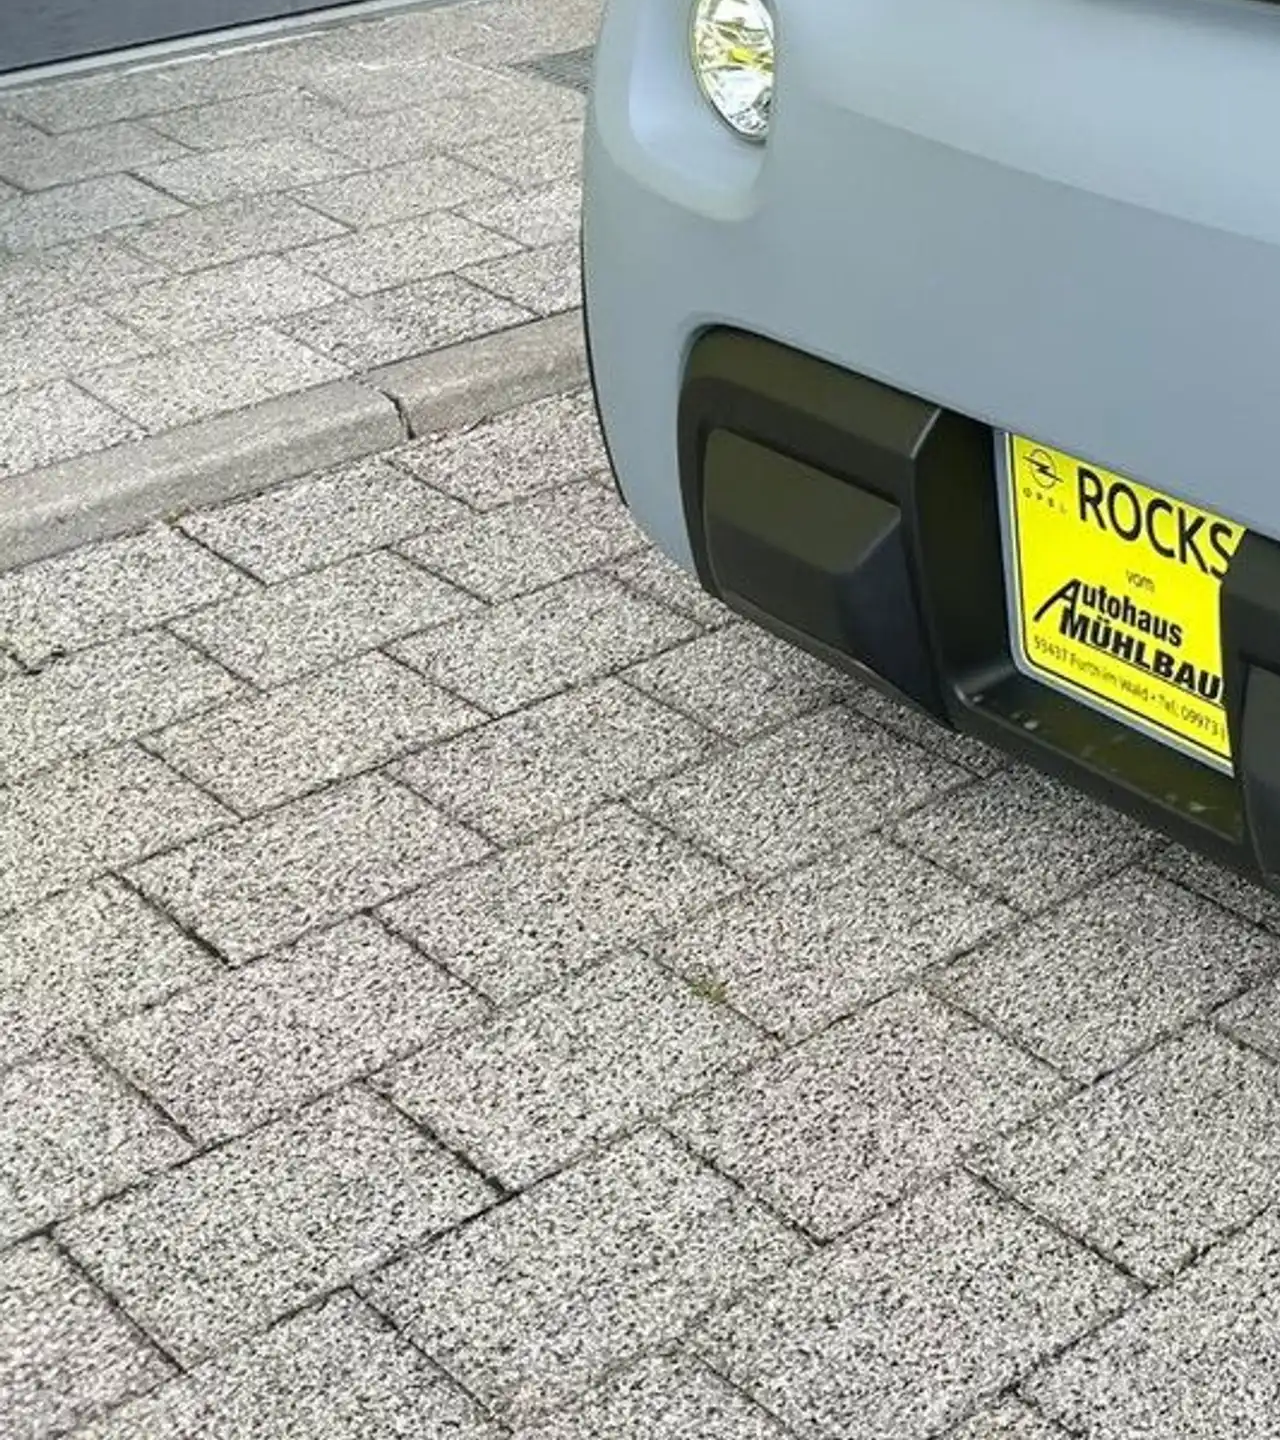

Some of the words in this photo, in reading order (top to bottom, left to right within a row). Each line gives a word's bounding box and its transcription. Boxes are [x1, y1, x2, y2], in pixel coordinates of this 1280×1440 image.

[1022, 486, 1068, 515] OPEL
[1077, 465, 1233, 579] ROCKS
[1033, 578, 1183, 647] Autohaus
[1126, 570, 1155, 593] vom
[1059, 607, 1223, 701] MÜHLBAU
